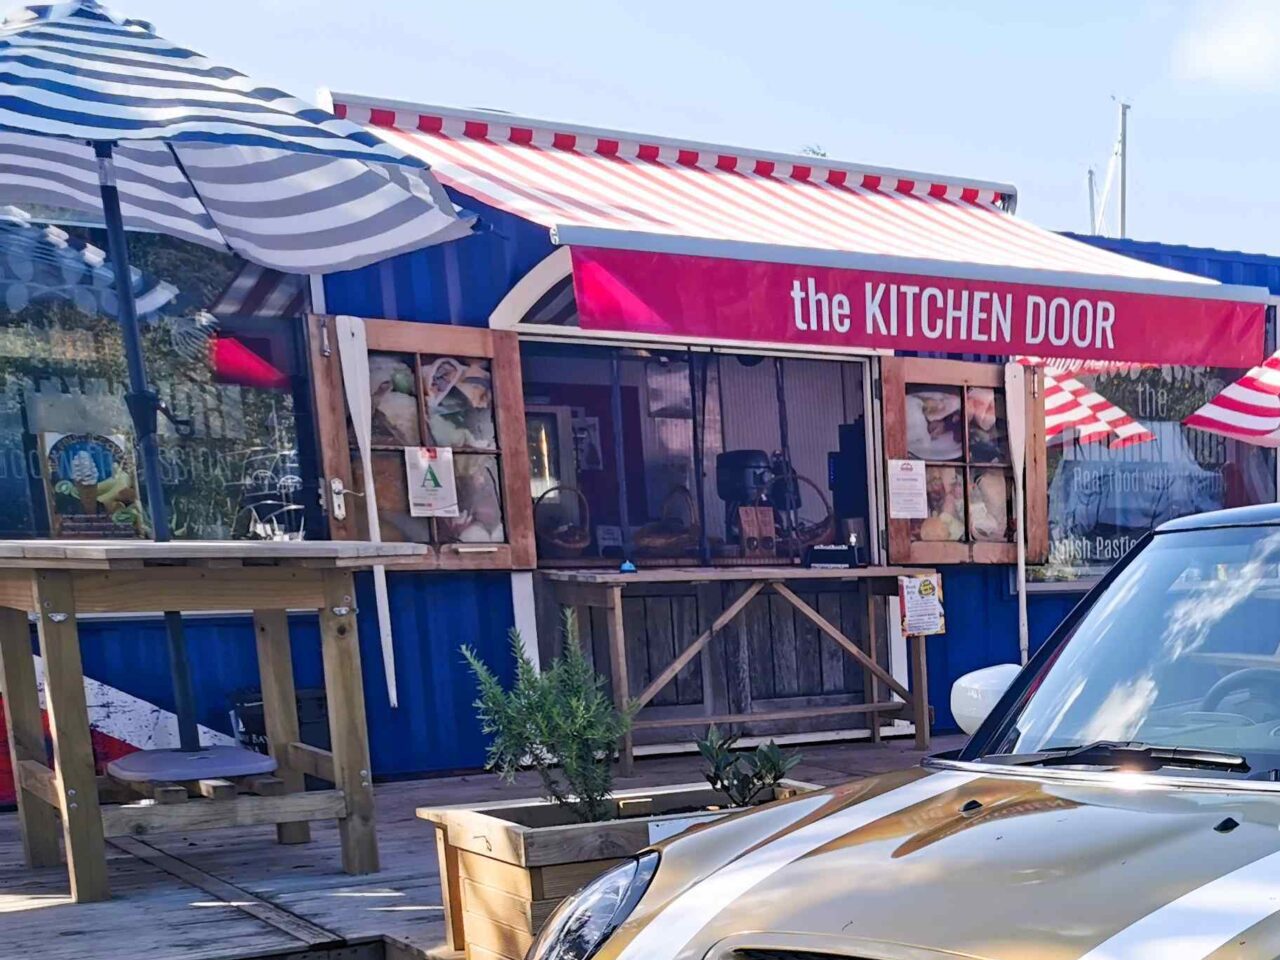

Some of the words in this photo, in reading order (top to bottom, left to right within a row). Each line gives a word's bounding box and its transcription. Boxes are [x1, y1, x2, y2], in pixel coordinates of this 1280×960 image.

[790, 277, 851, 333] the
[864, 282, 1013, 344] KITCHEN
[1024, 294, 1117, 350] DOOR
[1136, 382, 1168, 418] the
[420, 463, 443, 489] A
